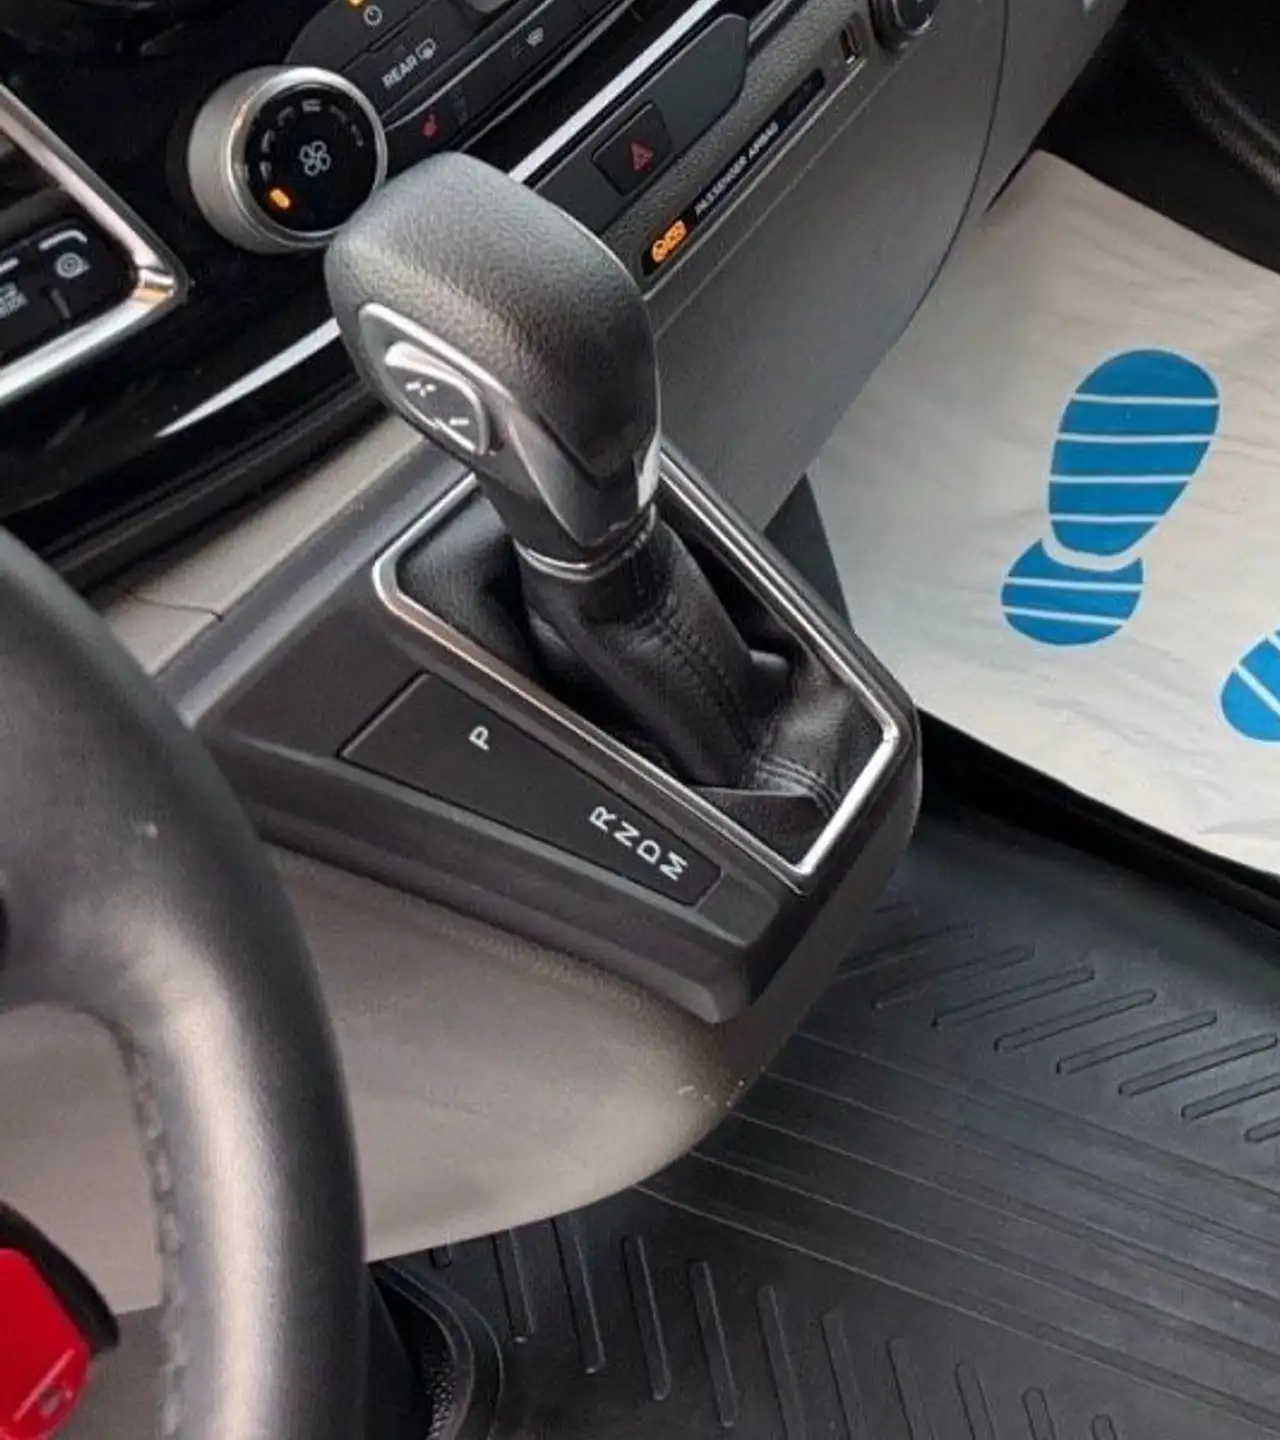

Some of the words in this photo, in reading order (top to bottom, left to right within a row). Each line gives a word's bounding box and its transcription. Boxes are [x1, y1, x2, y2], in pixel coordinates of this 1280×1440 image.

[382, 54, 419, 88] REAR
[652, 219, 687, 263] OFF
[468, 725, 490, 751] P
[589, 806, 617, 832] R
[613, 821, 641, 848] N
[636, 839, 662, 864] D
[659, 851, 689, 882] M
